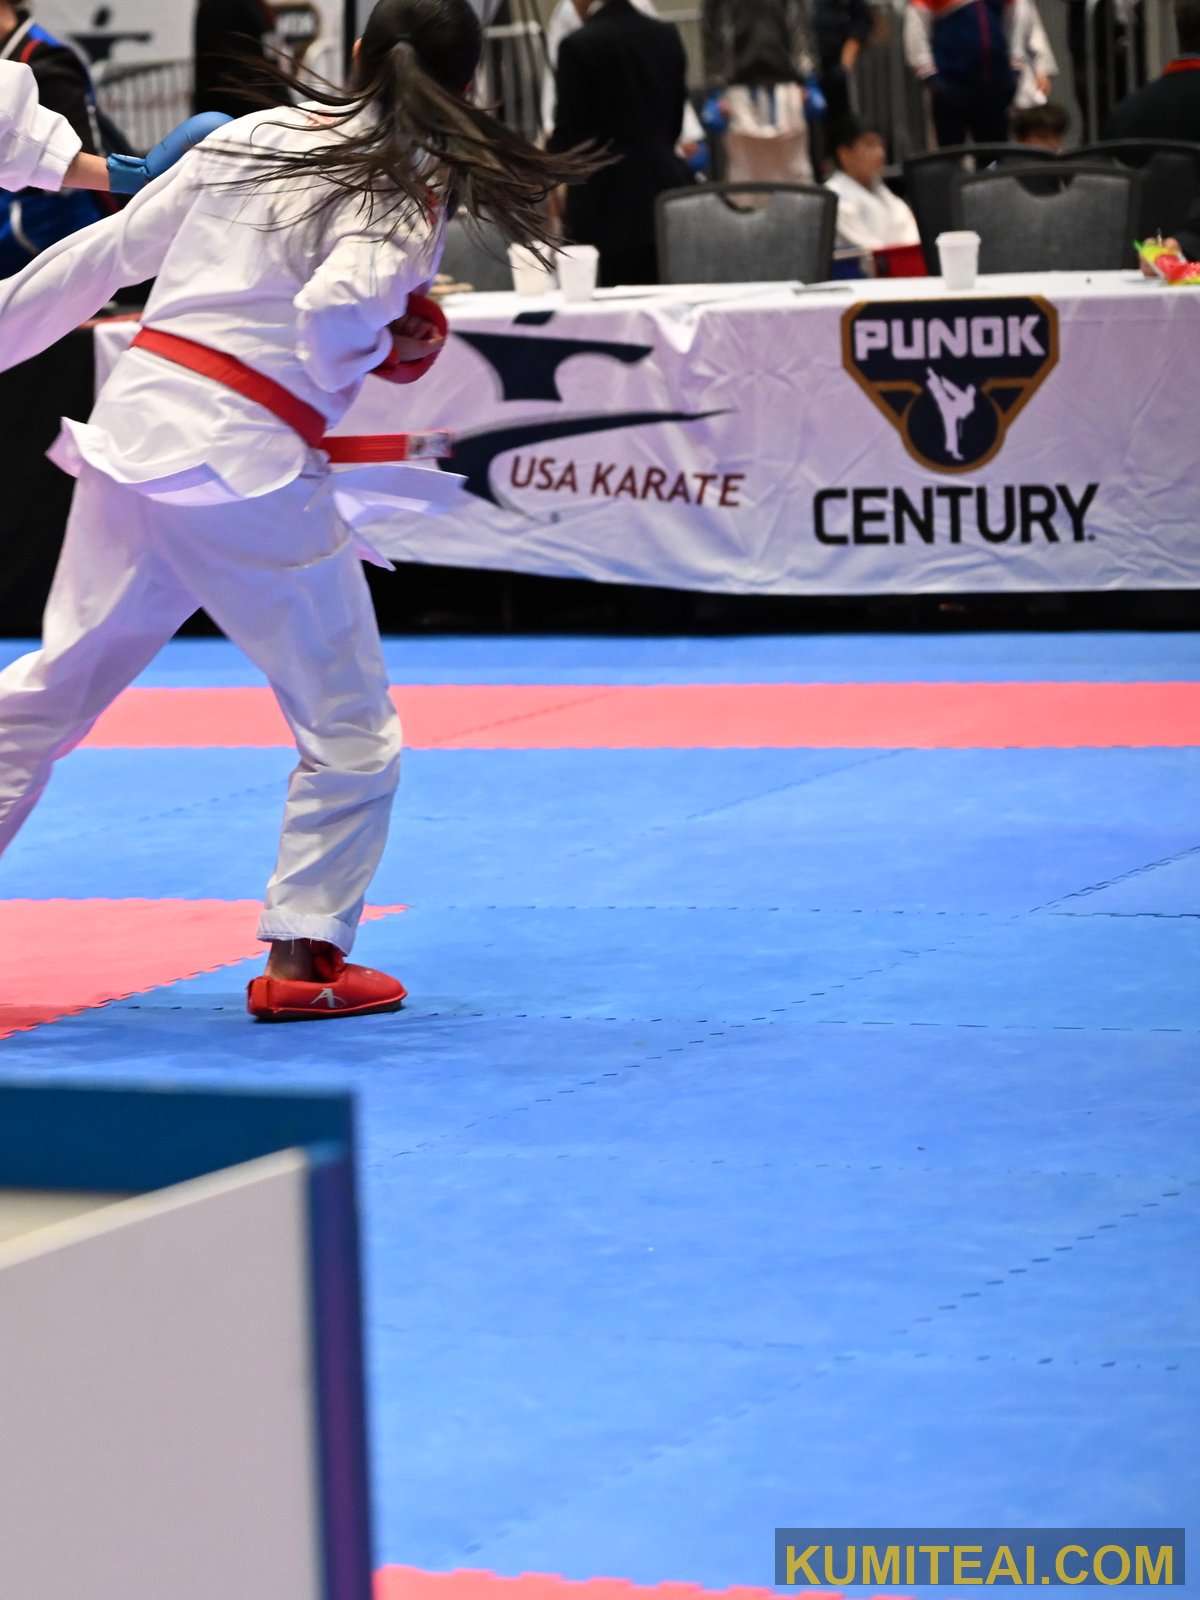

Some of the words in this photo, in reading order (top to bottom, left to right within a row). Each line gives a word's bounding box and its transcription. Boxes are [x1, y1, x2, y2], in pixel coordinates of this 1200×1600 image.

[854, 314, 1046, 361] PUNOK
[509, 455, 577, 493] USA
[590, 462, 745, 507] KARATE
[813, 482, 1099, 545] CENTURY
